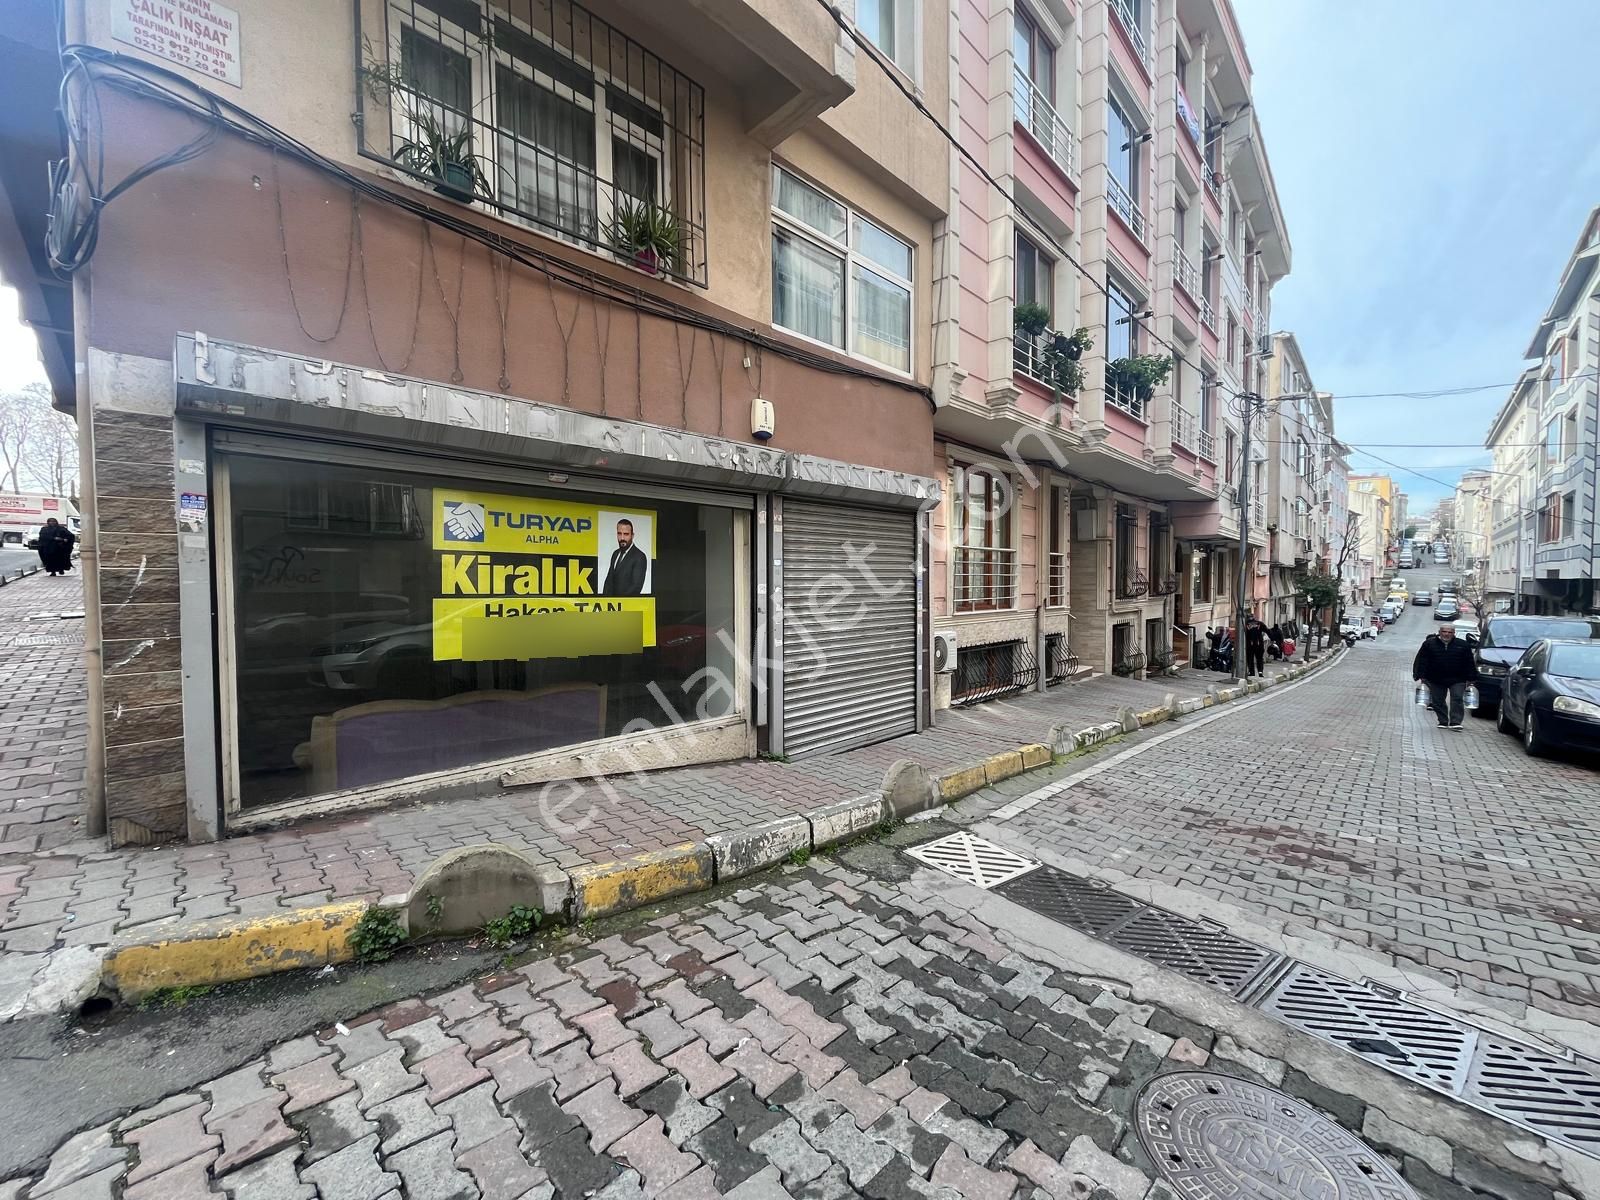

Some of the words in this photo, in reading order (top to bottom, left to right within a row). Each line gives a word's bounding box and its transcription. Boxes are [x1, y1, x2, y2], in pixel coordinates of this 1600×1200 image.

[127, 11, 181, 40] TARAFINDAN
[130, 0, 175, 24] ÇALIK
[179, 12, 229, 47] İNŞAAT
[134, 27, 165, 44] 0543
[194, 51, 209, 62] 70
[134, 37, 165, 53] 0212
[487, 510, 592, 534] TURYAP
[525, 534, 559, 545] ALPHA
[441, 553, 594, 595] Kiralık
